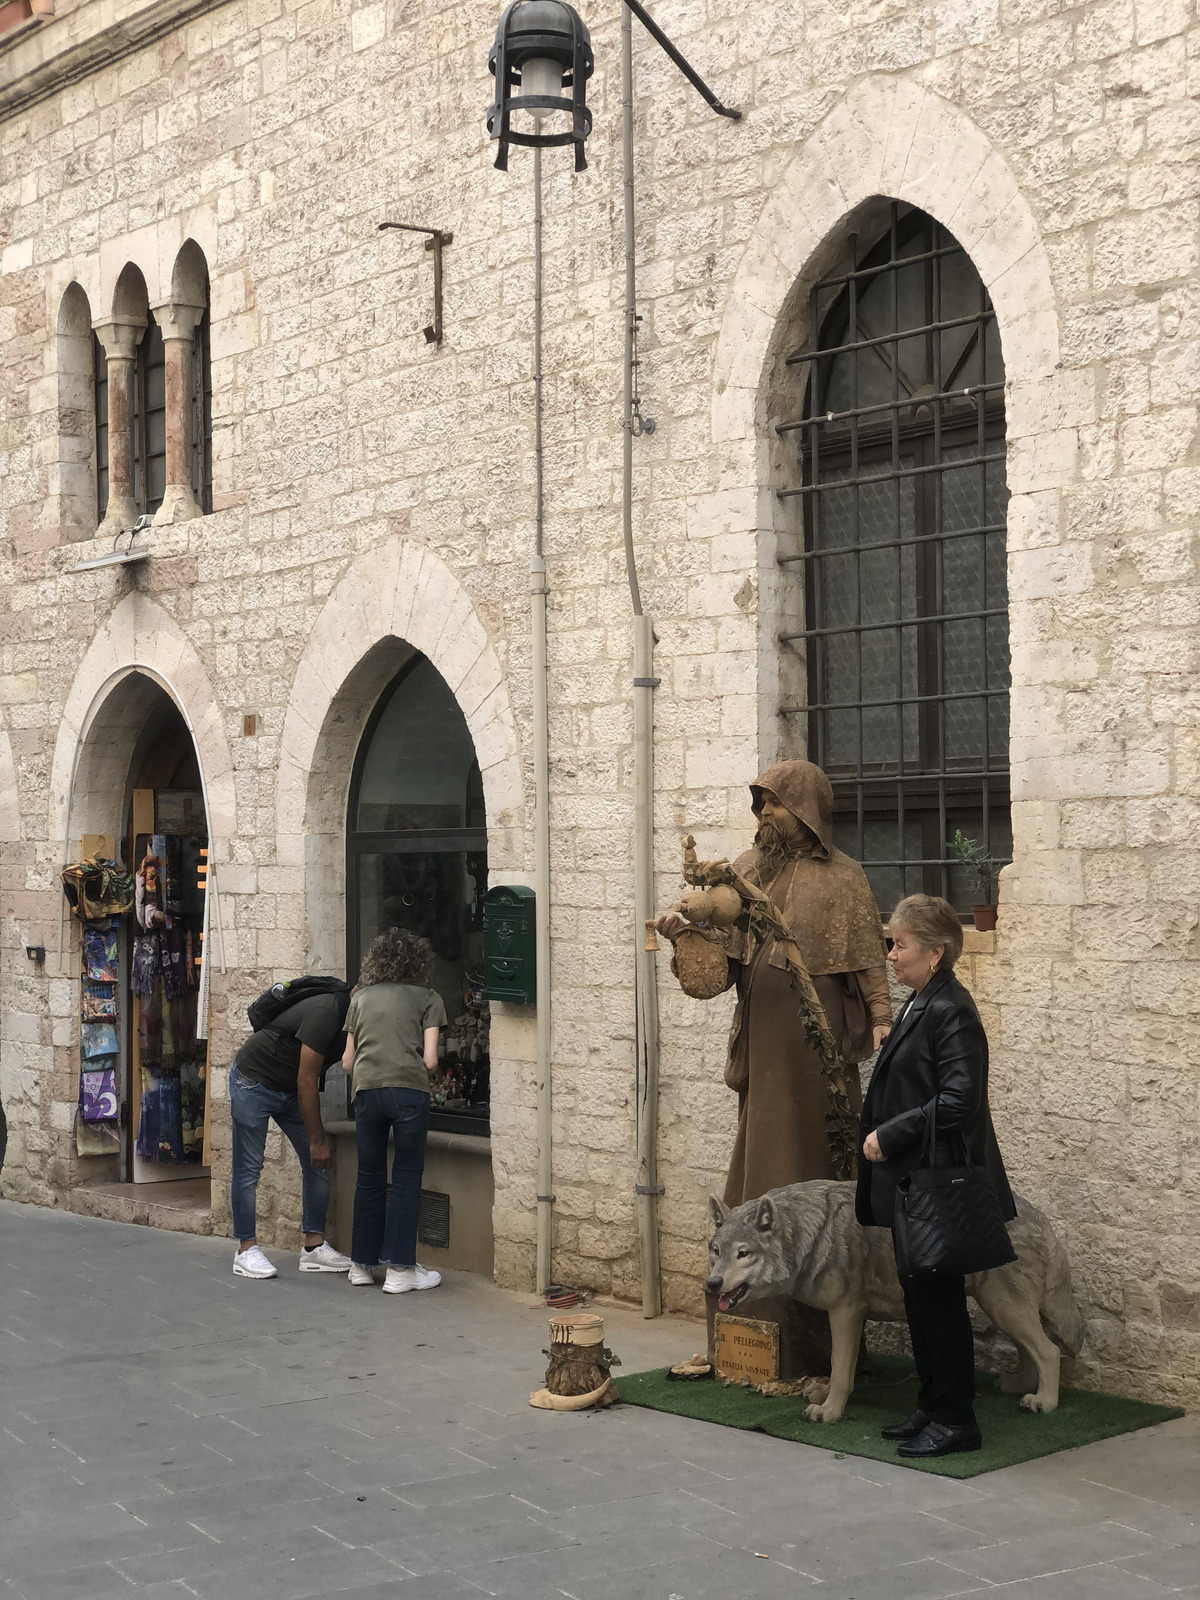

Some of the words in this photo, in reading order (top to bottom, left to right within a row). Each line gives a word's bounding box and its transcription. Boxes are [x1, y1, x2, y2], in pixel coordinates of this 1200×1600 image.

[720, 1333, 727, 1343] IL
[733, 1335, 773, 1351] PELLEGRINO
[721, 1360, 744, 1371] STATUA
[745, 1365, 771, 1377] VIVENTE
